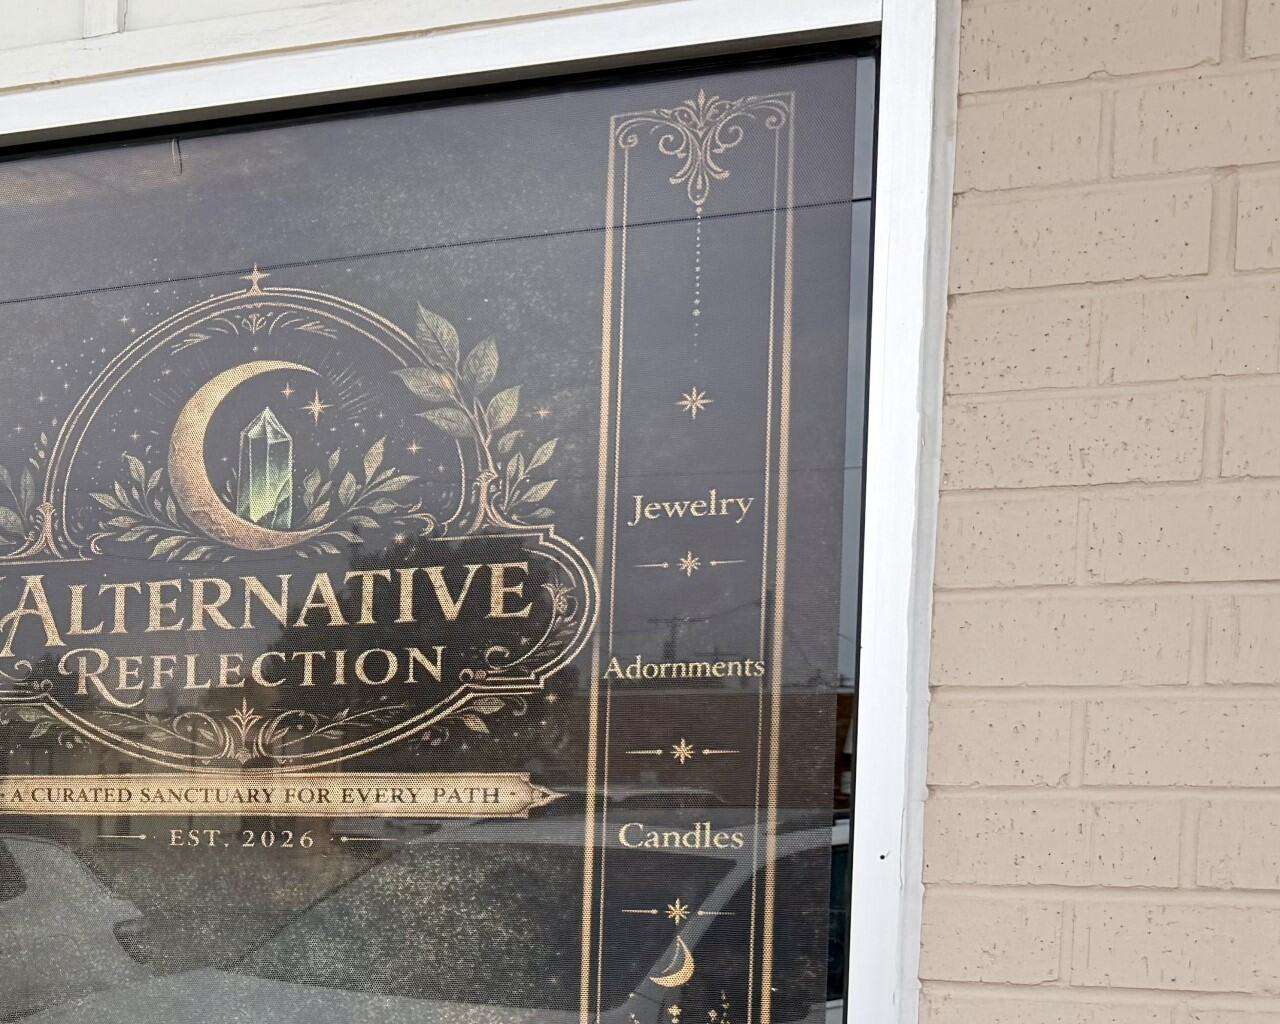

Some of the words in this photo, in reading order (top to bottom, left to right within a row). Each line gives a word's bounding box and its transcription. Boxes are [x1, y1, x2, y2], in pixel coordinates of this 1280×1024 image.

[627, 489, 754, 527] Jewelry
[57, 645, 445, 709] REFLECTION
[604, 654, 765, 681] Adornments
[10, 788, 27, 804] A
[31, 787, 133, 804] CURATED
[139, 787, 275, 803] SANCTUARY
[285, 787, 331, 803] FOR
[341, 787, 419, 803] EVERY
[432, 787, 501, 804] PATH
[169, 829, 230, 849] EST.
[242, 829, 315, 849] 2026
[618, 822, 745, 850] Candles
